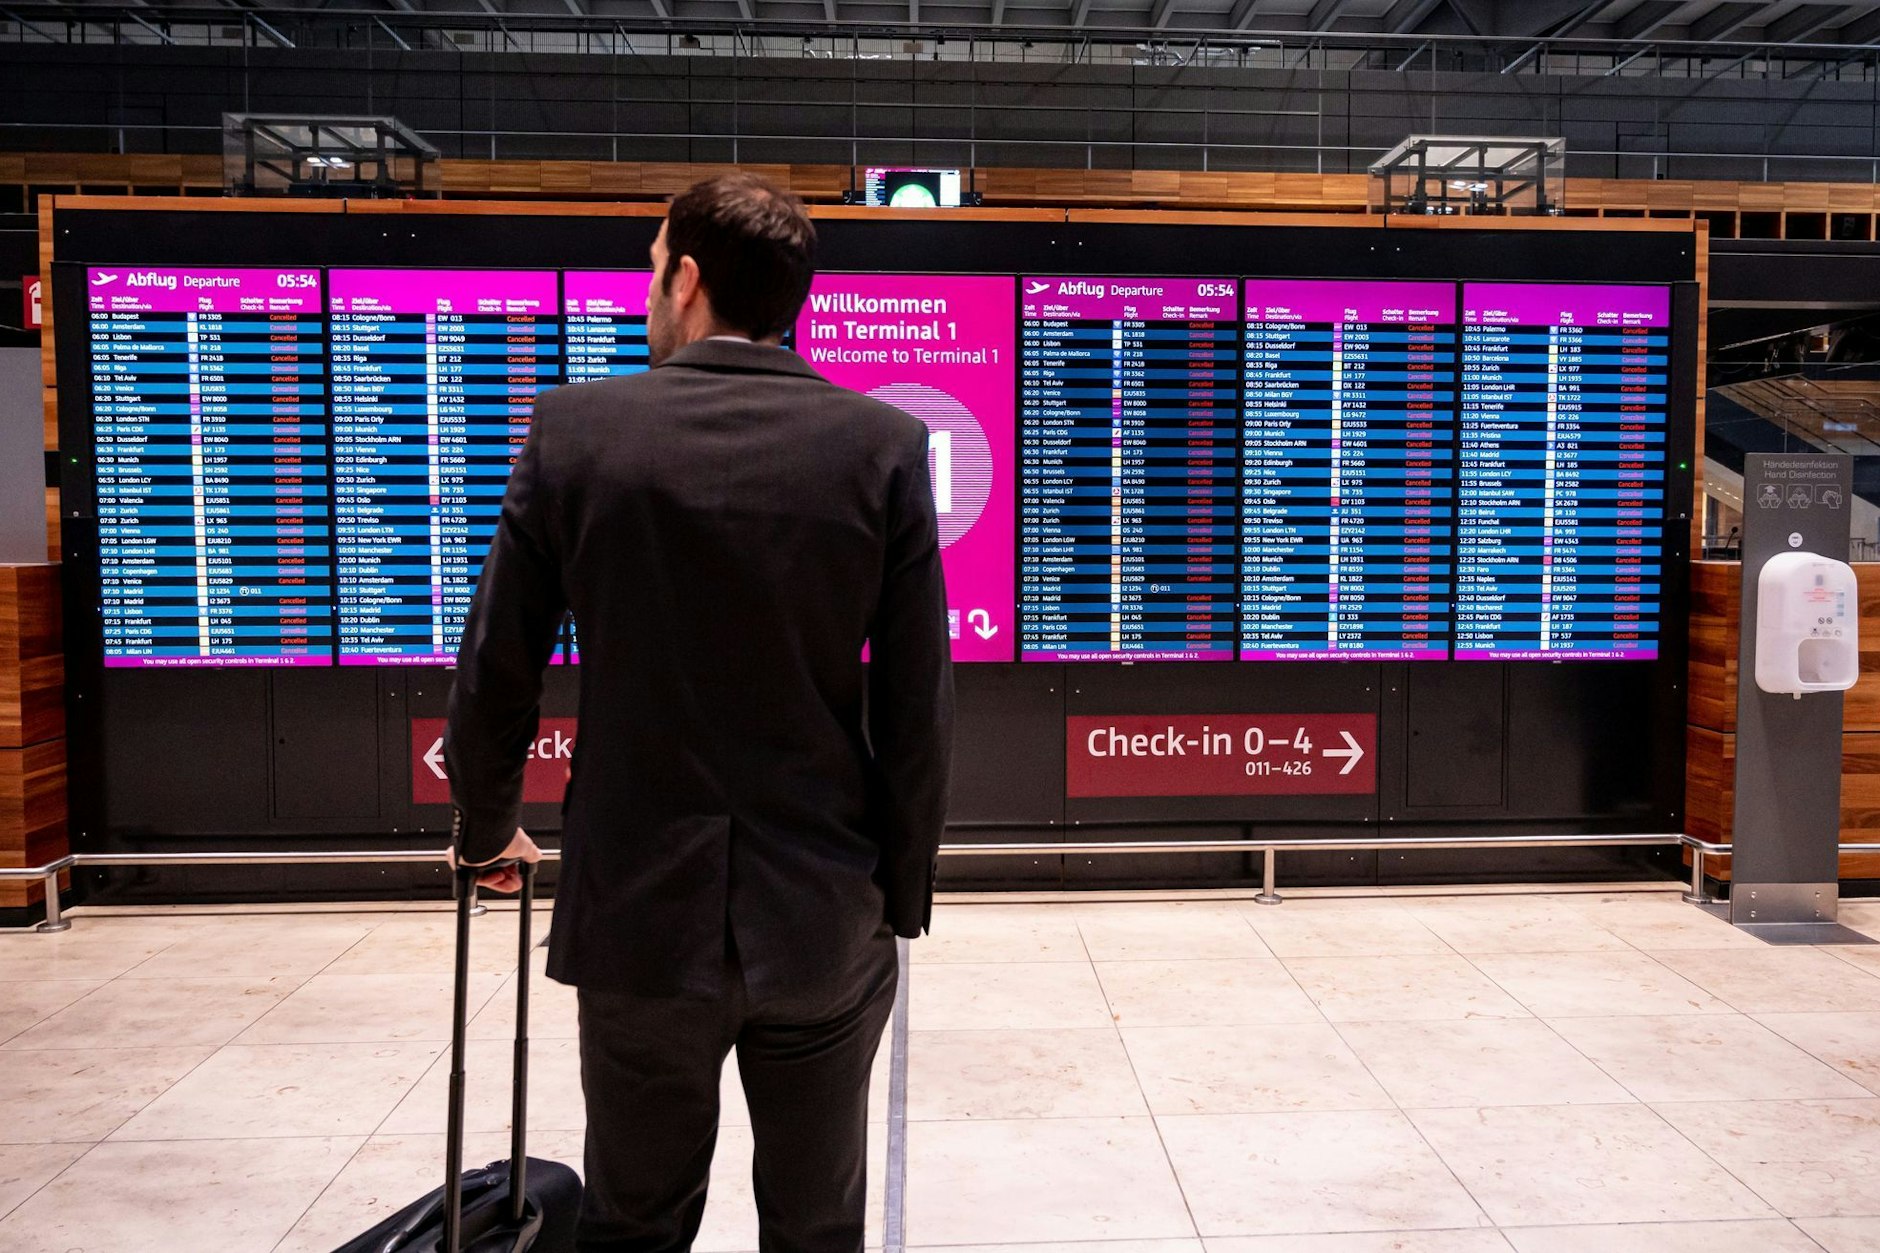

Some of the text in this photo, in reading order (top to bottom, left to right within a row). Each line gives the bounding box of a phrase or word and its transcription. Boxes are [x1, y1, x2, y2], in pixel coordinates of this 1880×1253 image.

[127, 273, 317, 290] Abflug Departure 05:54
[1058, 282, 1234, 298] Abflug Departure 05:54
[810, 294, 947, 314] Willkommen
[112, 313, 139, 321] Budapest
[352, 314, 395, 322] Cologne/Bonn
[811, 320, 956, 340] im Terminal 1
[353, 355, 367, 363] Riga
[811, 347, 998, 363] Welcome to Terminal 1
[1763, 460, 1839, 469] Händedesinfektion
[1765, 470, 1836, 479] Hand Disinfection
[436, 656, 457, 664] security
[1088, 726, 1232, 757] Check-in
